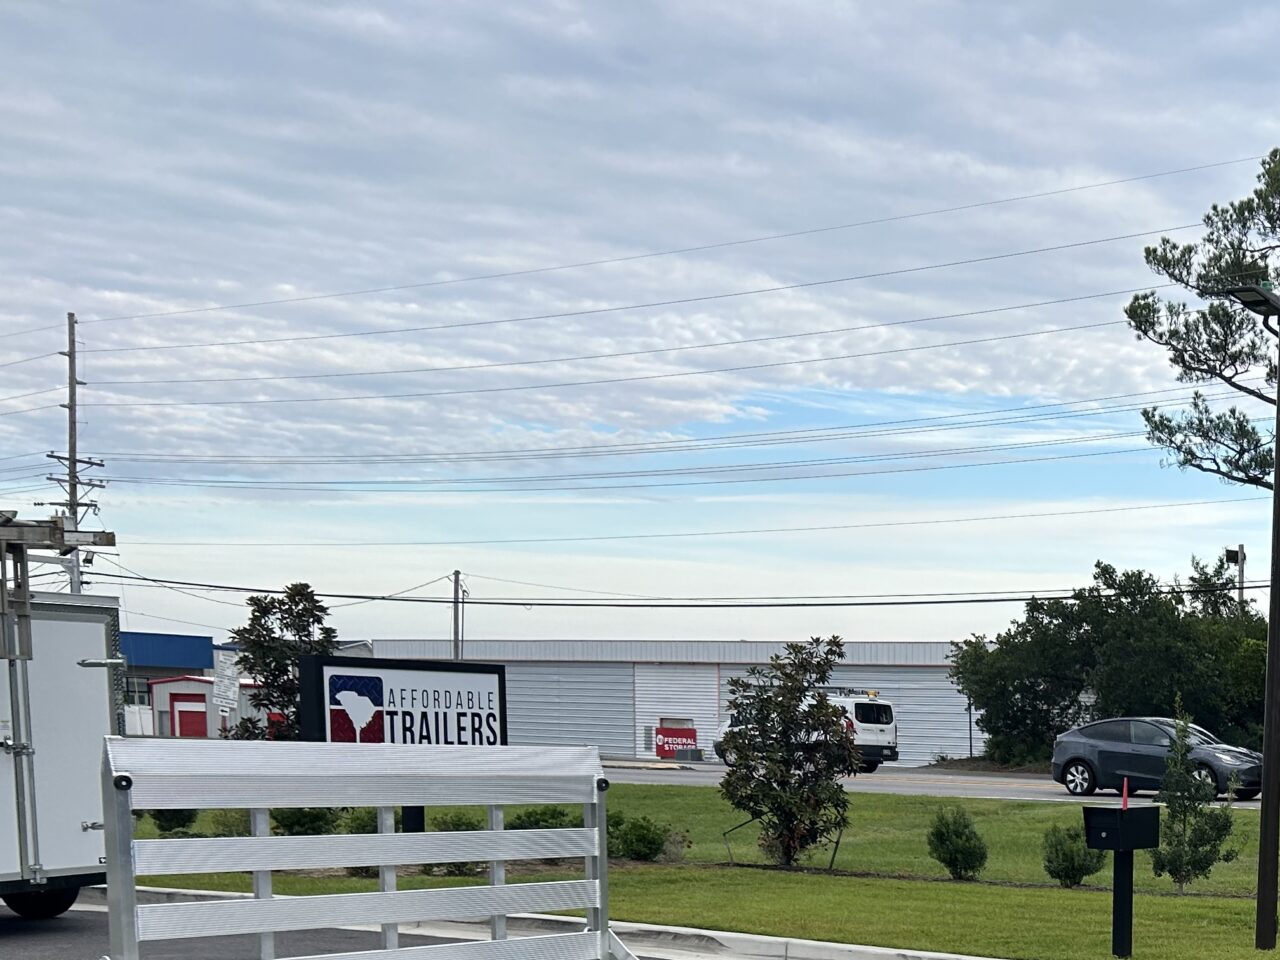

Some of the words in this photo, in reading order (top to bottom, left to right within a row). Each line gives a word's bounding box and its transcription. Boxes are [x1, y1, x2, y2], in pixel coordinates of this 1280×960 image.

[388, 688, 494, 710] AFFORDABLE
[385, 710, 498, 746] TRAILERS
[664, 737, 696, 745] FEDERAL
